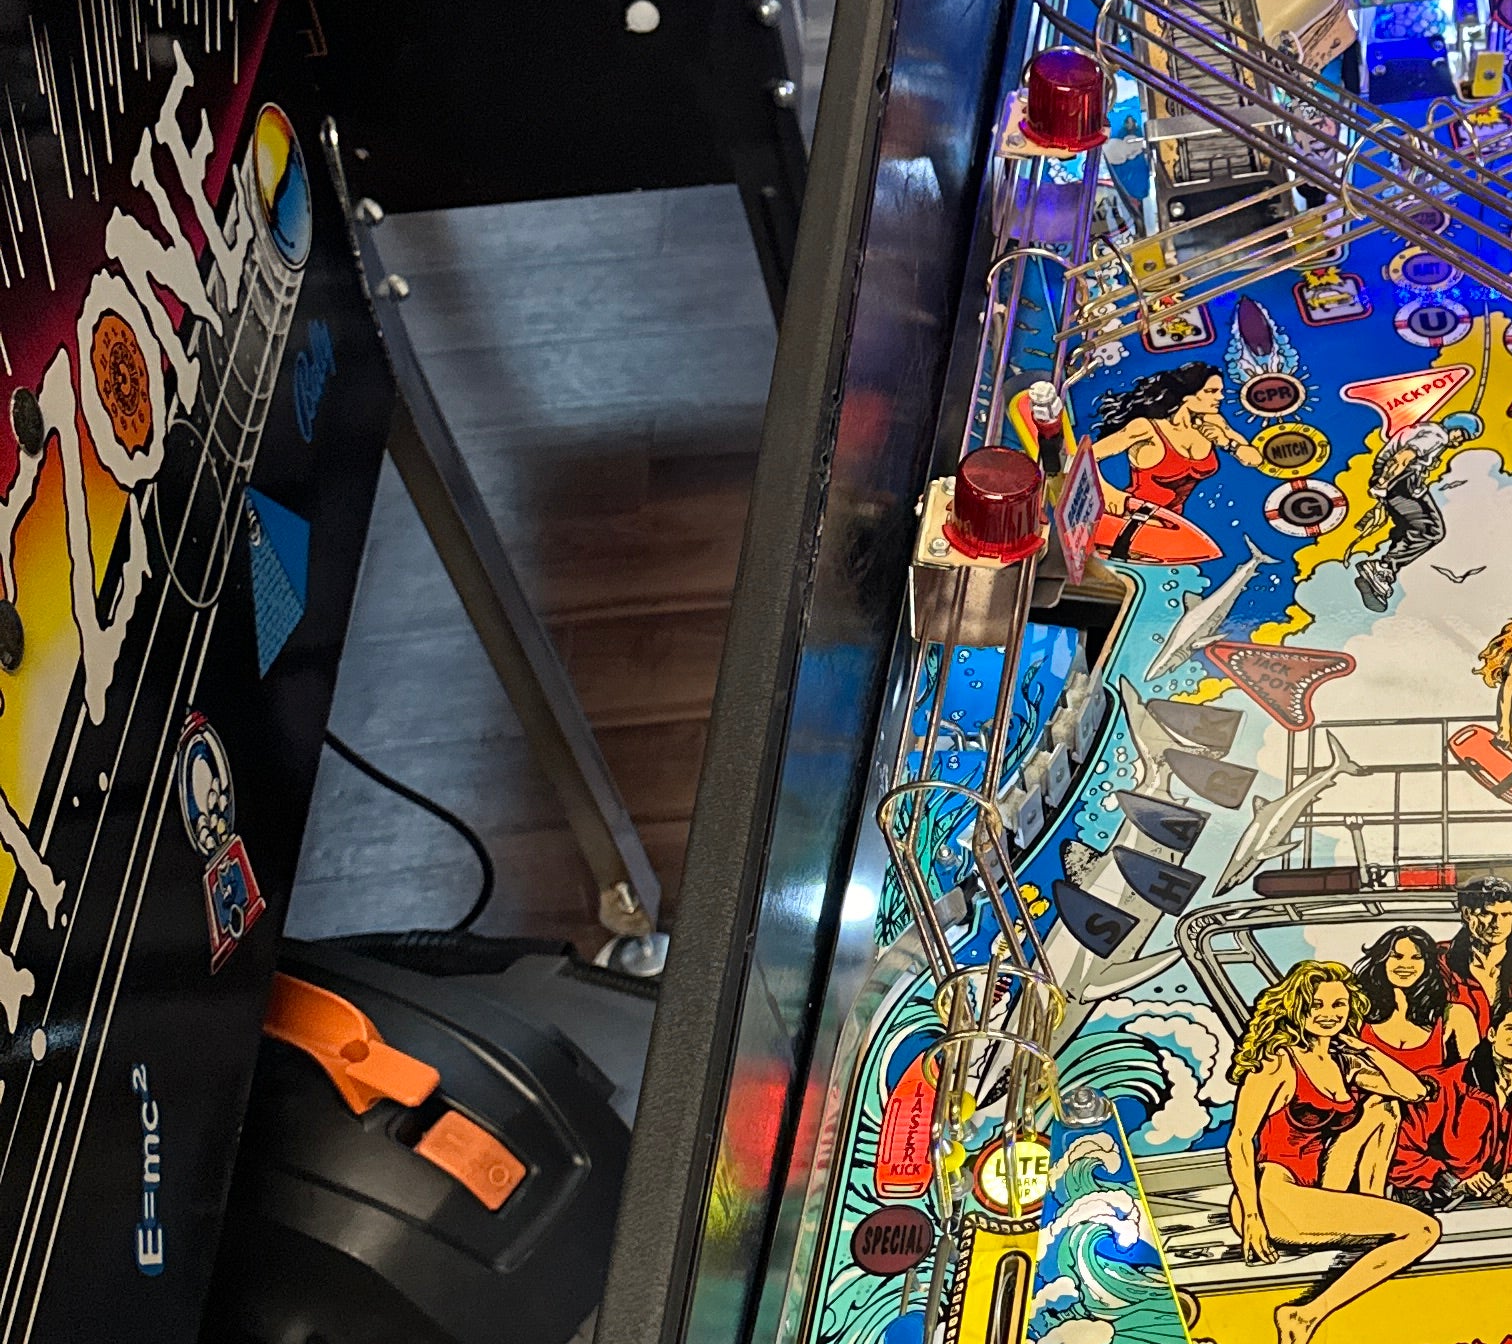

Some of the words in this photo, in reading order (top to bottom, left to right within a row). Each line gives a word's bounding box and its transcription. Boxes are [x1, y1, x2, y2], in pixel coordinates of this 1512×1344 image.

[1253, 386, 1293, 403] CPR
[1386, 372, 1454, 411] JACKPOT
[1271, 441, 1309, 459] MITCH
[1252, 658, 1291, 677] JACK
[1260, 673, 1297, 693] POT
[901, 1081, 925, 1163] LASER
[890, 1163, 922, 1176] KICK
[995, 1156, 1048, 1177] LTE
[862, 1224, 923, 1256] SPECIAL
